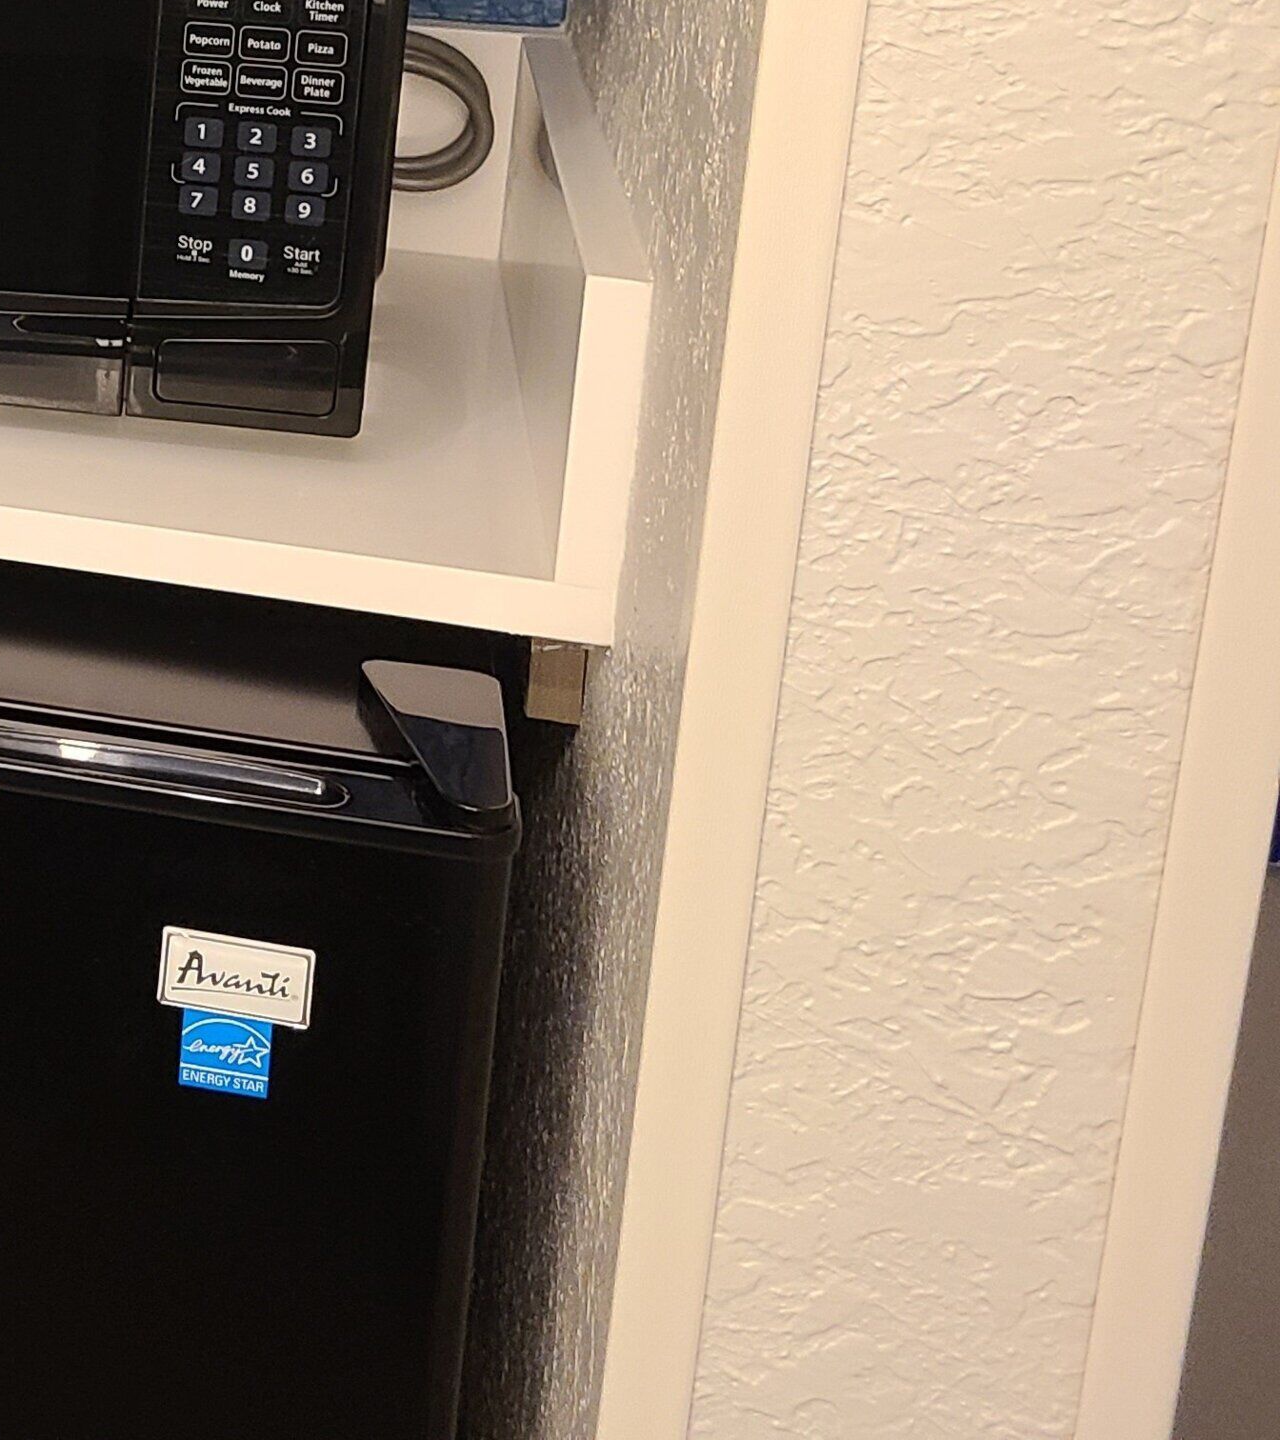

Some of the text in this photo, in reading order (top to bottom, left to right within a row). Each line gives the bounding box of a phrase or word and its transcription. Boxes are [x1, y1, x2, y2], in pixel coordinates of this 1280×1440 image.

[252, 0, 282, 13] Clock
[309, 10, 339, 23] Timer
[189, 33, 231, 48] Popcorn
[247, 37, 282, 51] Potato
[307, 42, 335, 56] Pizza
[191, 64, 223, 76] Frozen
[184, 74, 228, 88] Vegetable
[239, 74, 283, 89] Beverage
[300, 74, 336, 88] Dinner
[303, 87, 331, 99] Plate
[228, 102, 292, 118] Express Cook
[197, 122, 207, 140] 1
[248, 127, 263, 146] 2
[303, 132, 317, 150] 3
[192, 157, 206, 175] 4
[246, 162, 260, 180] 5
[300, 167, 315, 185] 6
[190, 191, 203, 209] 7
[242, 196, 257, 214] 8
[297, 201, 312, 219] 9
[177, 234, 213, 254] Stop
[240, 243, 254, 262] 0
[283, 245, 321, 263] Start
[228, 269, 265, 283] Memory
[176, 949, 290, 999] Avanti
[189, 1038, 243, 1064] energy
[182, 1068, 264, 1094] ENERGY STAR
